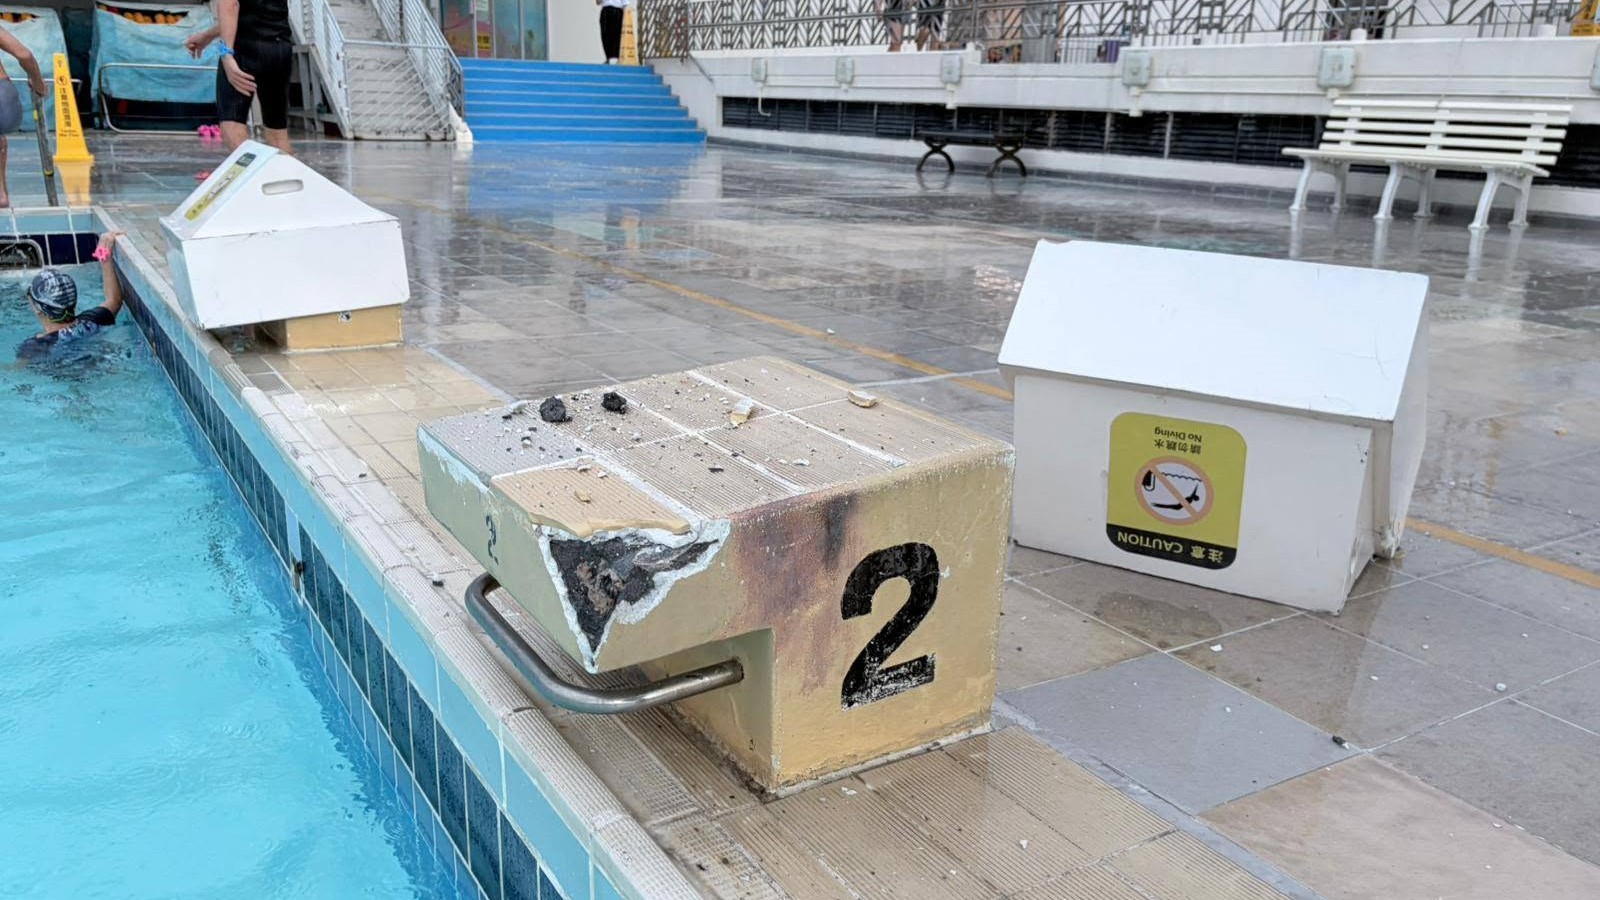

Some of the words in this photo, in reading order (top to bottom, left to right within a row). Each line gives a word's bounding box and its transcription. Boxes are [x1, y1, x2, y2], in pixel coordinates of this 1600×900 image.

[1154, 427, 1186, 440] Diving
[1188, 435, 1202, 443] No
[1154, 439, 1202, 454] 請勿跳水
[1117, 531, 1183, 554] CAUTION
[1191, 545, 1223, 563] 注意
[841, 542, 939, 711] 2
